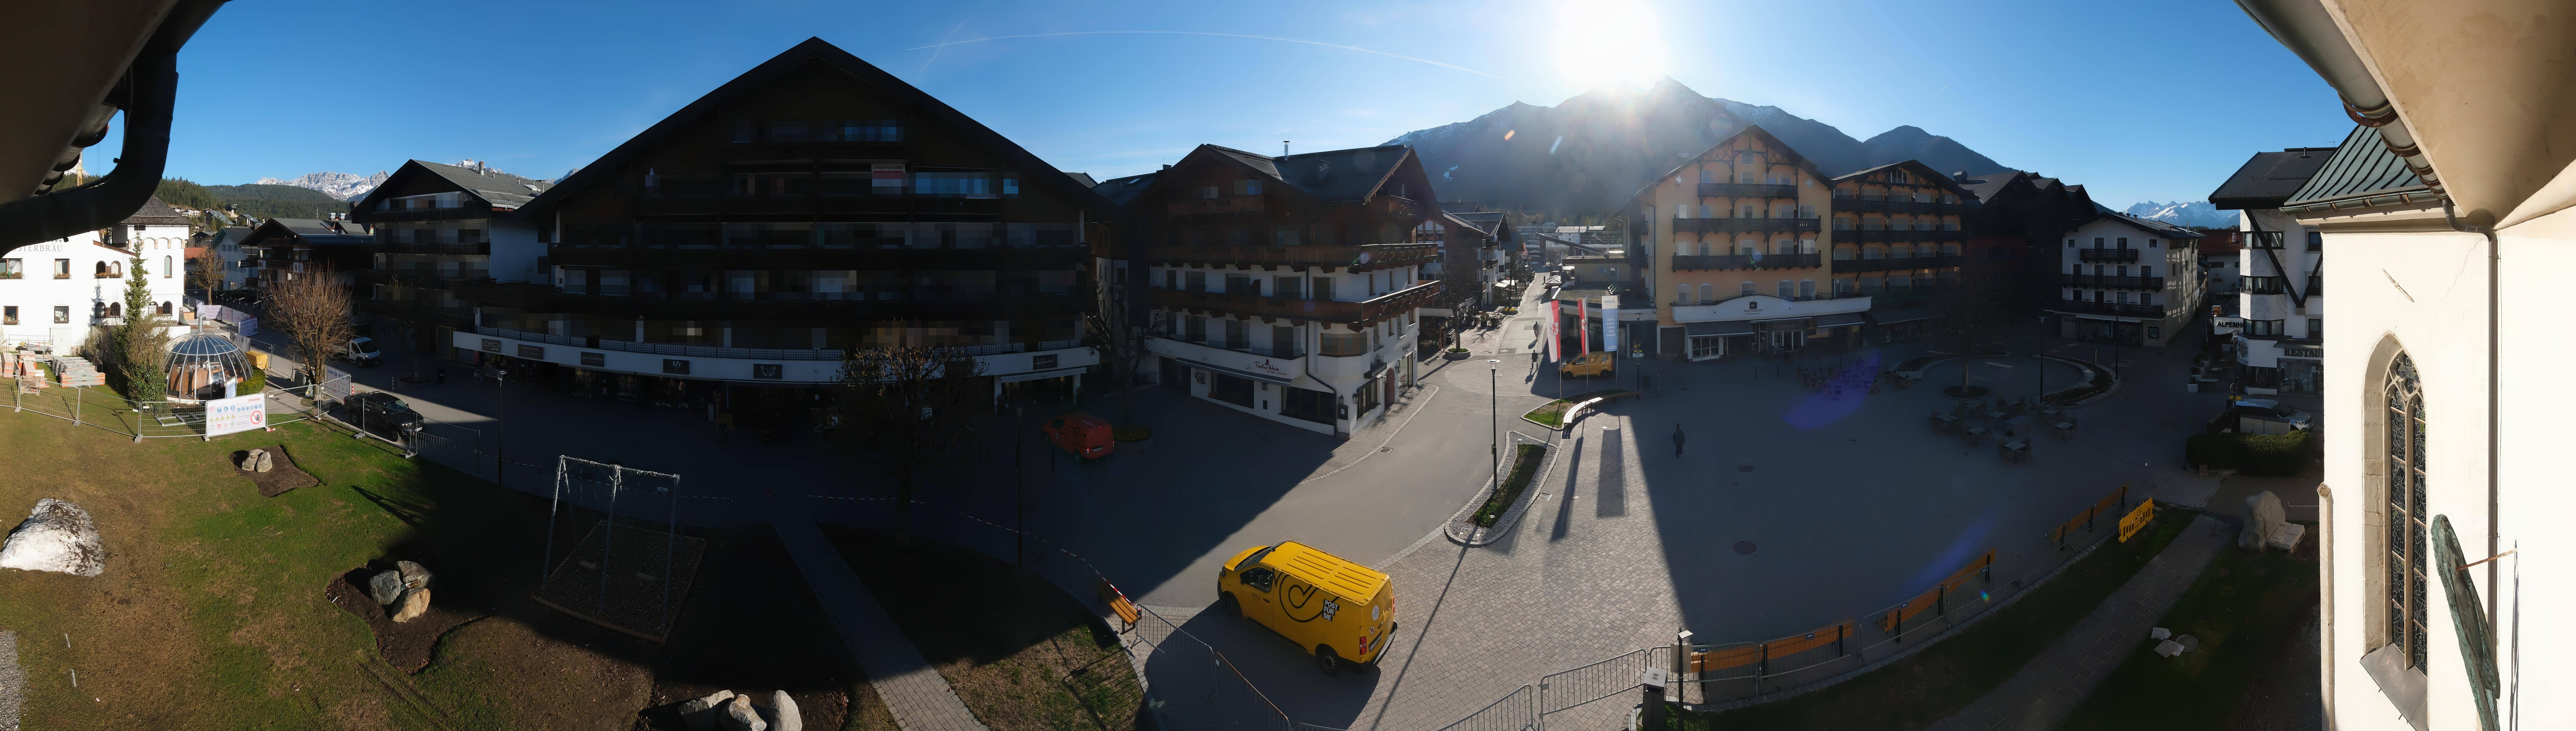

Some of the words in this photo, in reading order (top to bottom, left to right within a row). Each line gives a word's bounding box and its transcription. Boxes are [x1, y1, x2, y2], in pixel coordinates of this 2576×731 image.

[1402, 343, 1411, 351] SAILER
[2238, 355, 2249, 365] Kaltschmid
[671, 361, 682, 370] My
[1372, 364, 1386, 377] RESTAURANT
[1325, 600, 1338, 610] POST
[1324, 606, 1334, 615] FÜR
